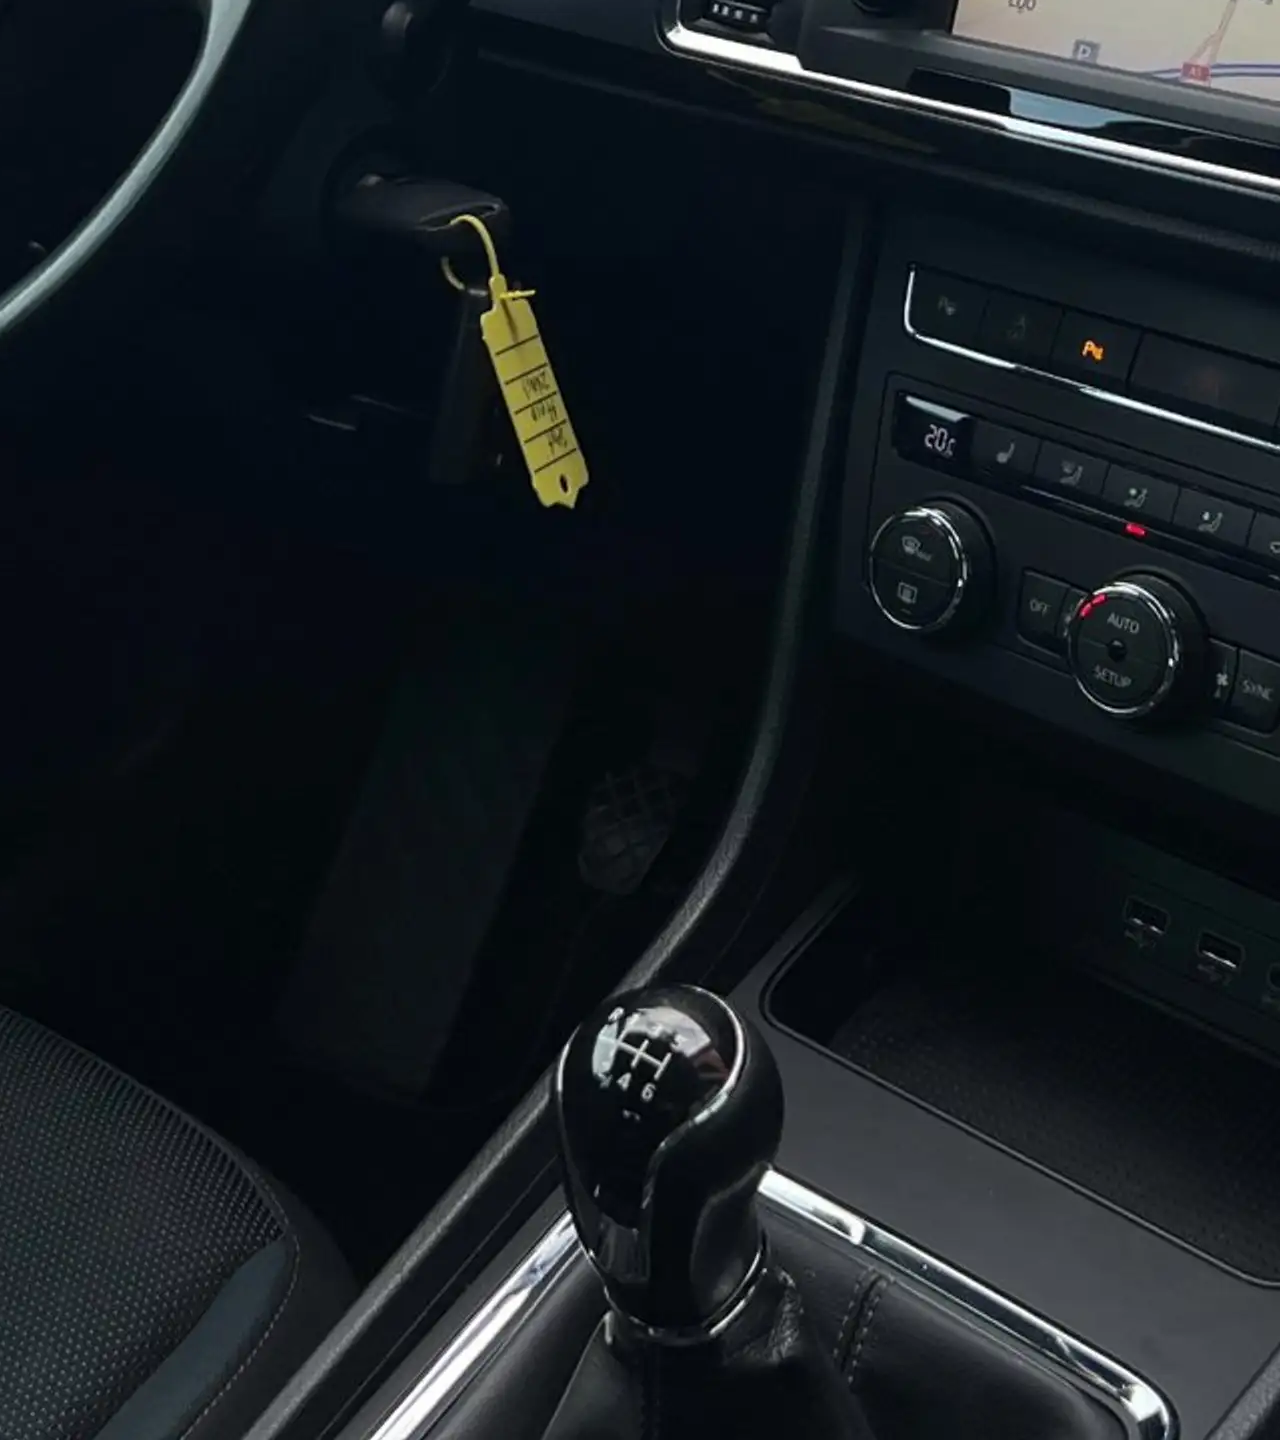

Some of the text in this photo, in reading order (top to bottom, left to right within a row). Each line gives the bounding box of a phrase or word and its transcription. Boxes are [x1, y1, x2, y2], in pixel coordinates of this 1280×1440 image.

[1029, 598, 1051, 615] OFF
[1107, 612, 1139, 635] AUTO
[1094, 666, 1131, 689] SETUP
[1242, 680, 1273, 701] SYNC
[616, 1072, 631, 1091] 4
[641, 1083, 657, 1103] 6
